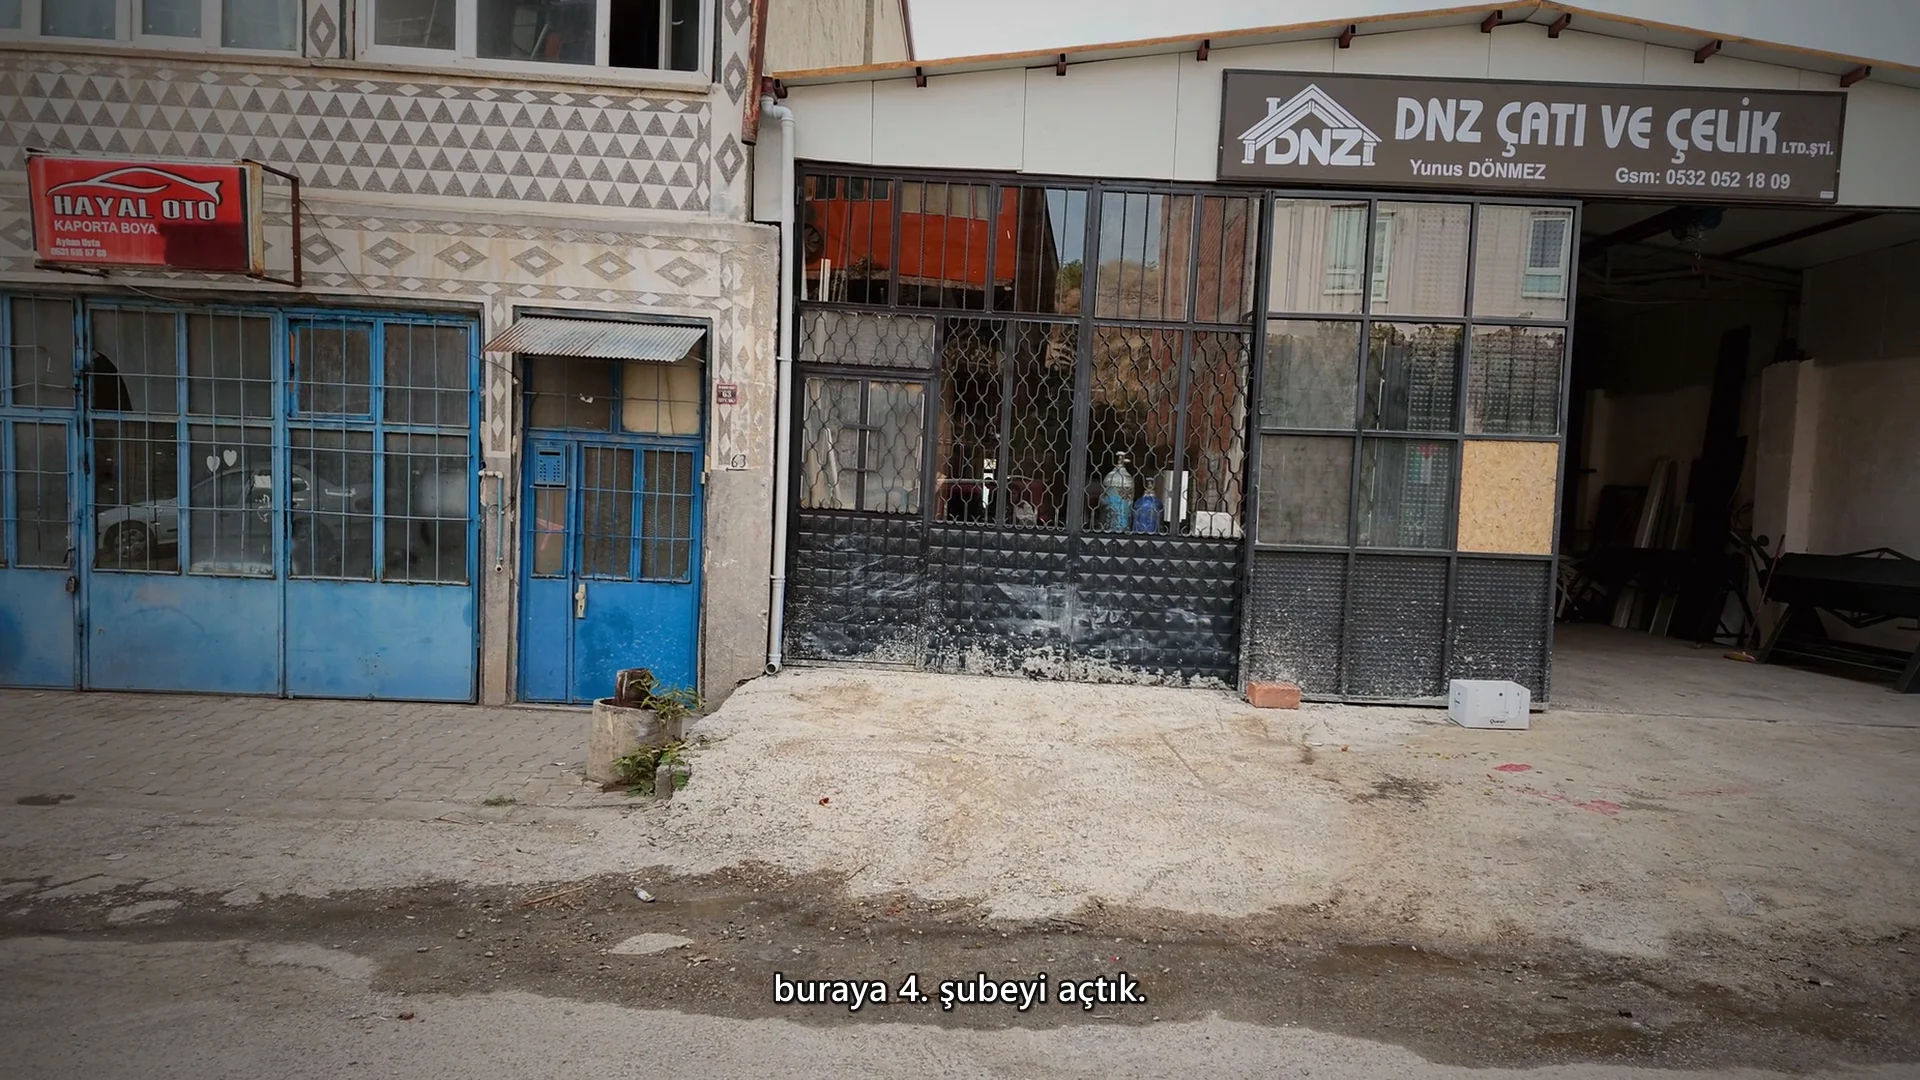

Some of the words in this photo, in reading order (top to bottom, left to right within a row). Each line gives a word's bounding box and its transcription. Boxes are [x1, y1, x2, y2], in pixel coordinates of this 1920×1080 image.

[1395, 97, 1484, 143] DNZ
[1496, 101, 1587, 157] ÇATI
[1601, 105, 1653, 149] VE
[1666, 97, 1781, 164] ÇELİK
[1782, 141, 1834, 158] LTD.ŞTİ.
[1264, 128, 1363, 166] DNZ
[1409, 159, 1463, 176] Yunus
[1468, 158, 1546, 180] DÖNMEZ
[1615, 167, 1660, 184] Gsm:
[1665, 169, 1706, 187] 0532
[1710, 171, 1741, 187] 052
[1746, 172, 1765, 188] 18
[1770, 173, 1791, 190] 09
[54, 195, 153, 219] HAYAL
[162, 199, 216, 220] OTO
[54, 220, 118, 233] KAPORTA
[121, 222, 158, 235] BOYA
[81, 238, 100, 248] Usta
[722, 390, 732, 398] 63
[731, 454, 747, 468] 63
